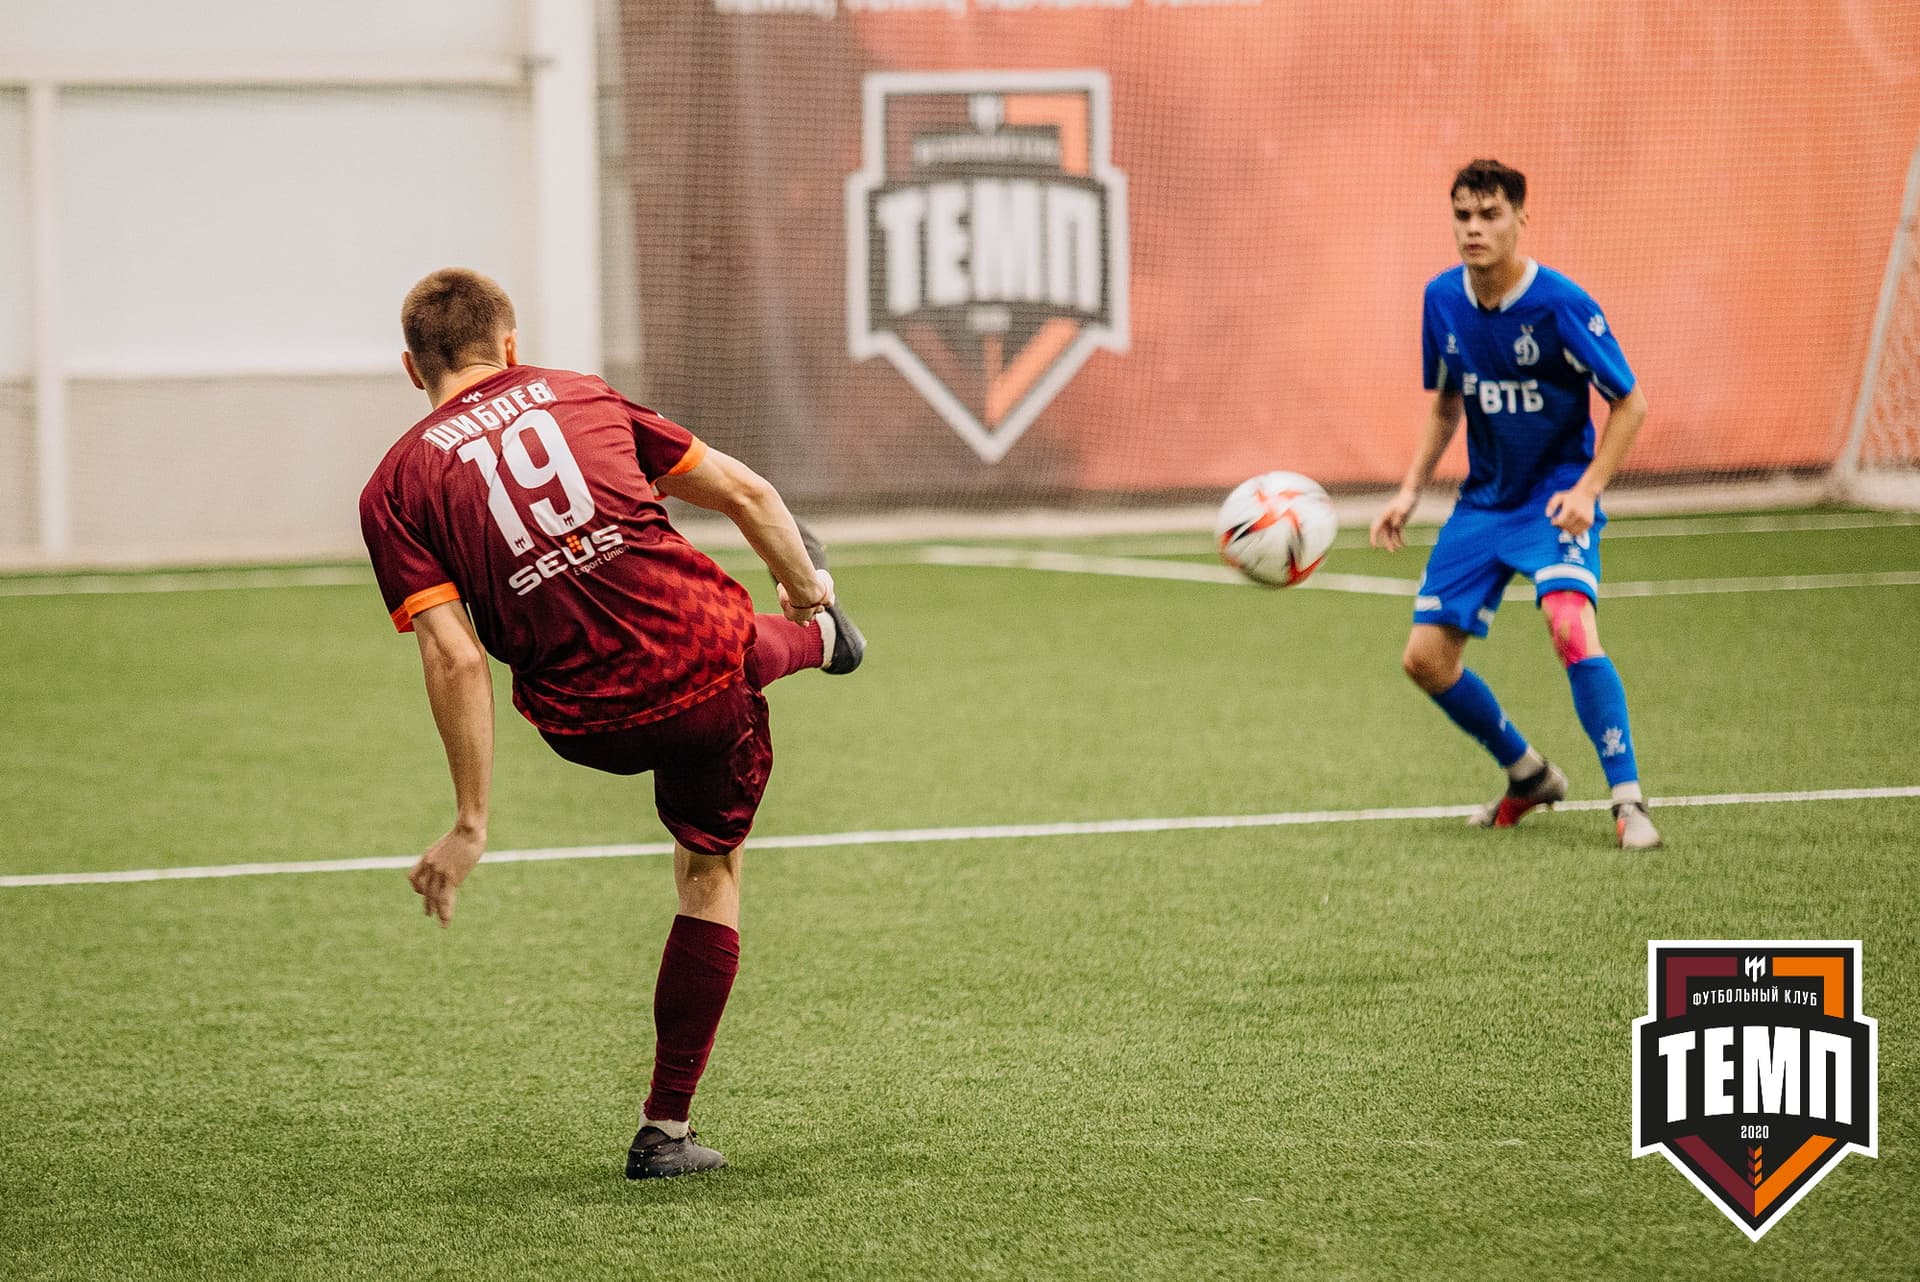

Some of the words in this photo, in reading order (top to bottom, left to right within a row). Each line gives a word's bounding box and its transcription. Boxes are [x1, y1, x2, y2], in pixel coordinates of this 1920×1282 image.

[878, 180, 1100, 314] ТЕМП
[422, 381, 554, 452] ШИБАЕВ
[1479, 379, 1544, 414] ВТБ
[456, 408, 596, 557] 19
[508, 525, 624, 596] SEUS
[602, 544, 630, 561] Union
